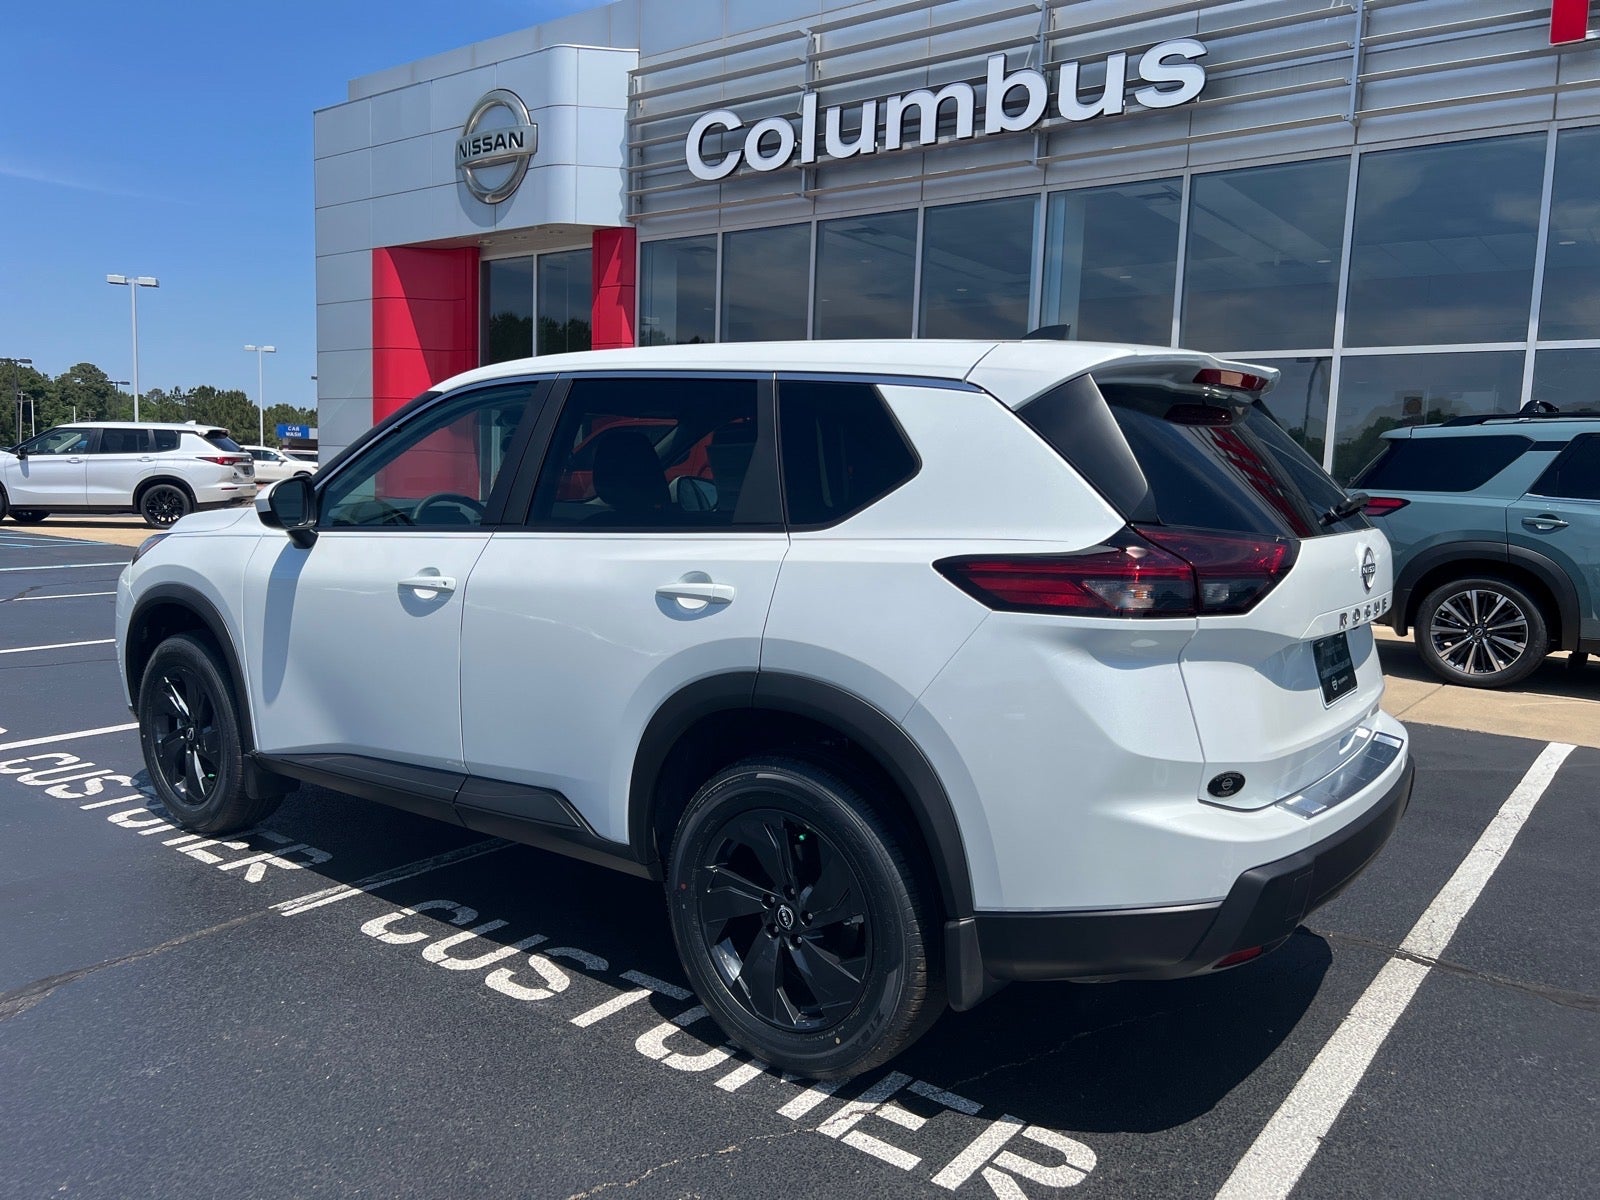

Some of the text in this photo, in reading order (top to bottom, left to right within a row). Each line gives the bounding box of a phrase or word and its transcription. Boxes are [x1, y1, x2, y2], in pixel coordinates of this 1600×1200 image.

[685, 38, 1208, 181] Columbus
[459, 132, 524, 158] NISSAN
[1339, 598, 1387, 626] ROGUE
